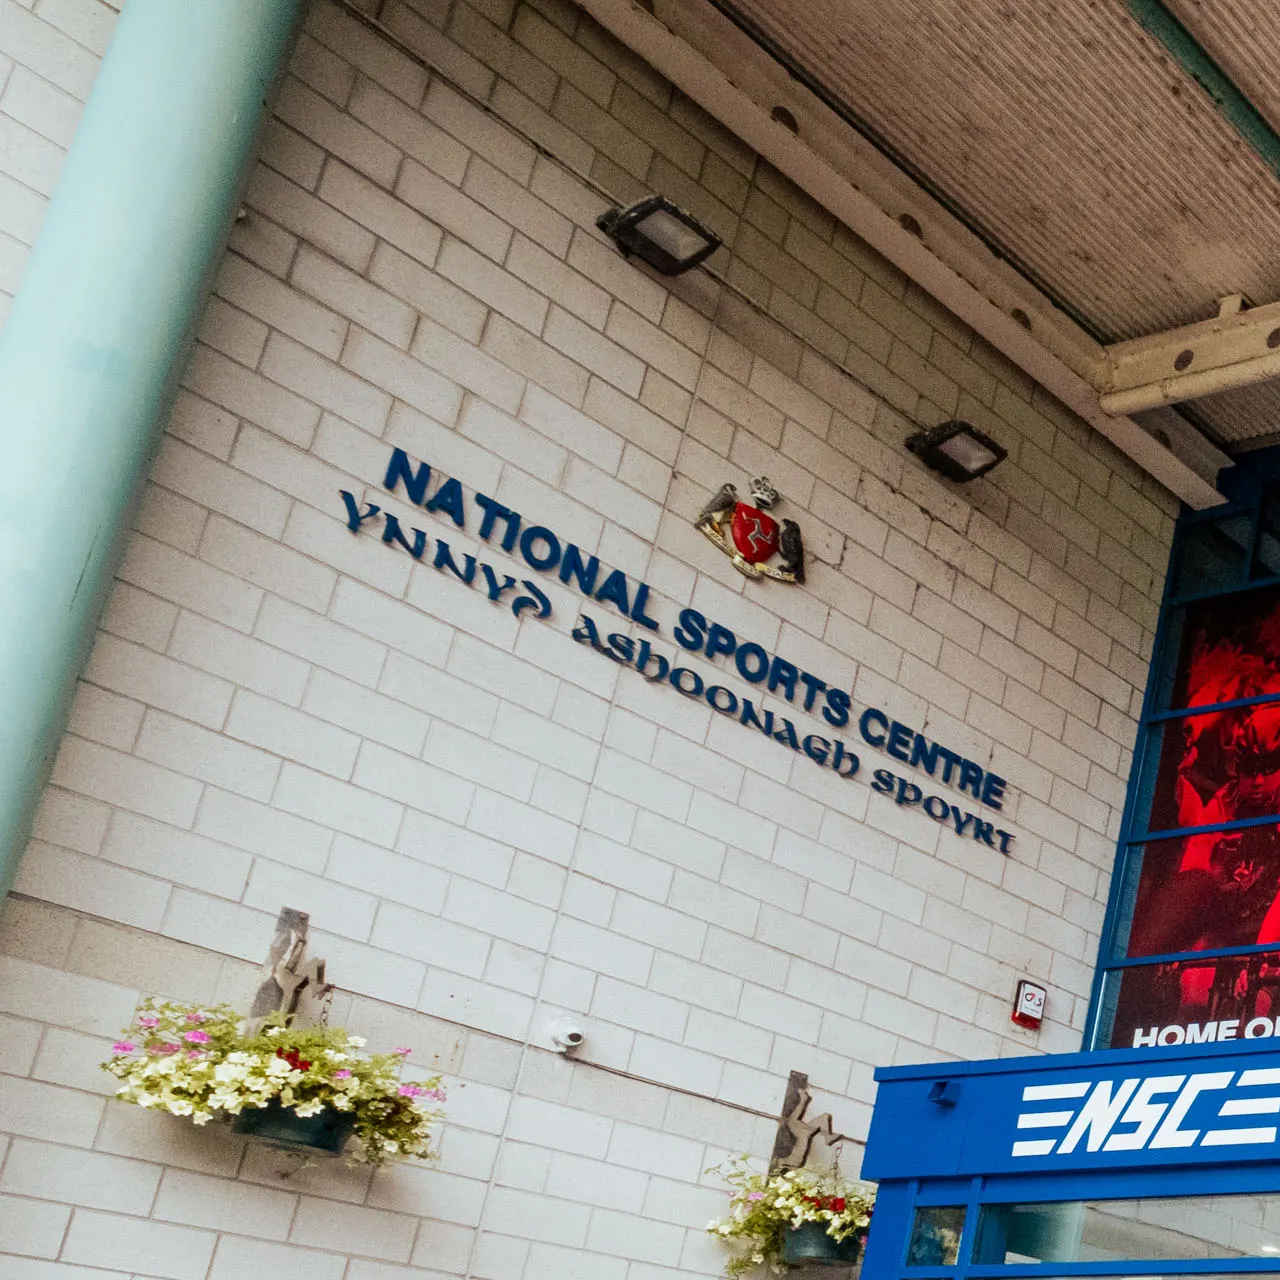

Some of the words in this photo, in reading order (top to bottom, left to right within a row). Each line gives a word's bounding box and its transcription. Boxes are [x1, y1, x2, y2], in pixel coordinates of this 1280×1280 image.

[383, 447, 659, 631] NATIONAL
[673, 608, 851, 728] SPORTS
[859, 708, 1008, 810] CENTRE
[1132, 1019, 1239, 1049] HOME
